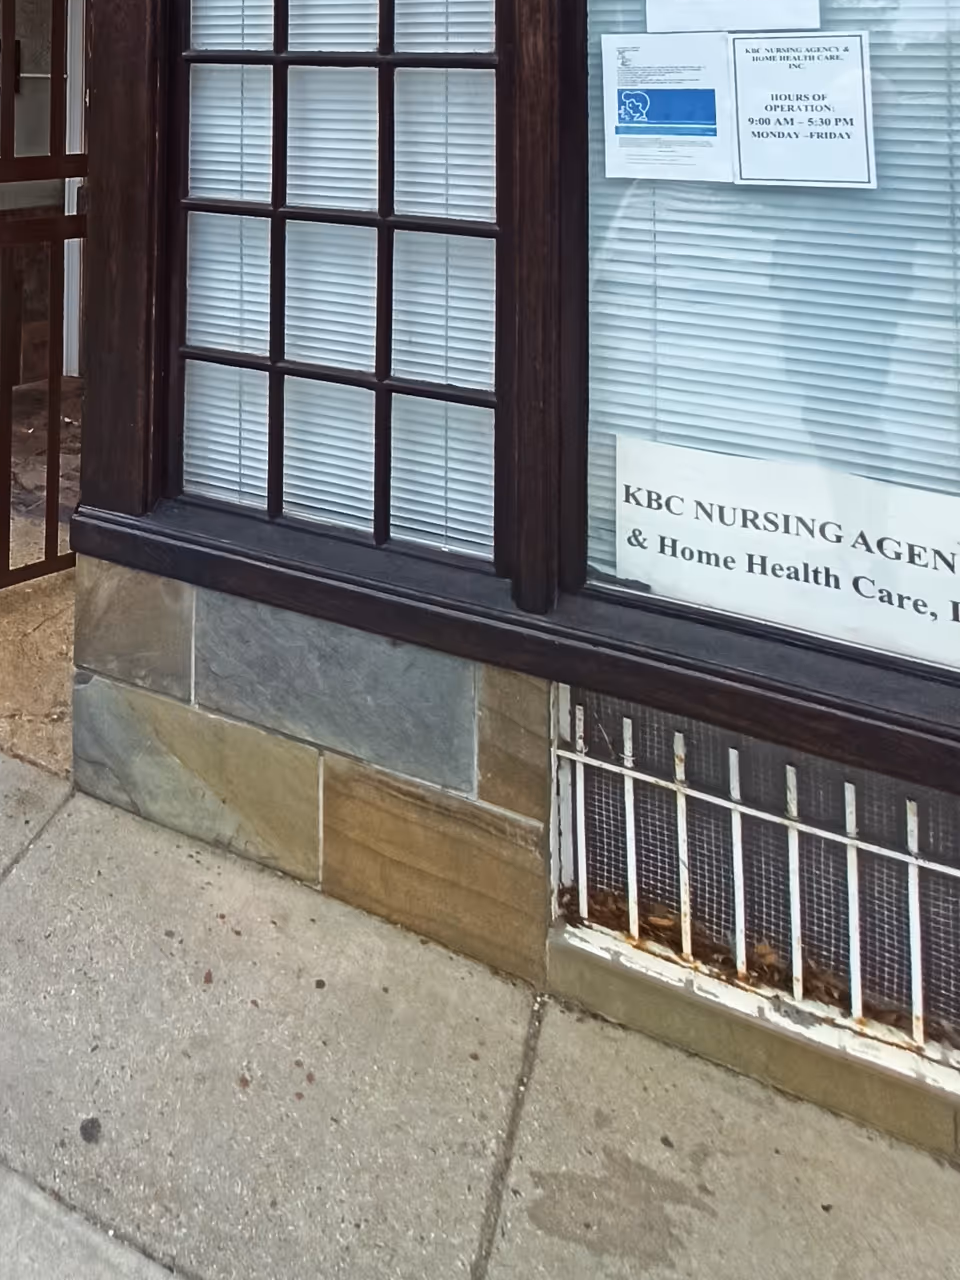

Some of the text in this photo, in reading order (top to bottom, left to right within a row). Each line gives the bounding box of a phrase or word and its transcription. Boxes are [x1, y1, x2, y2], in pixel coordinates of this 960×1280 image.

[765, 46, 803, 54] NURSING
[770, 93, 828, 101] HOURS OF
[764, 104, 835, 112] OPERATION:
[748, 117, 771, 126] 9:00
[774, 117, 795, 126] AM
[807, 117, 831, 126] 5:30
[834, 117, 854, 126] PM
[751, 131, 801, 139] MONDAY
[623, 484, 685, 516] KBC
[694, 499, 844, 544] NURSING
[626, 527, 648, 550] &
[658, 534, 736, 571] Home
[746, 552, 842, 590] Health
[852, 574, 938, 622] Care,
